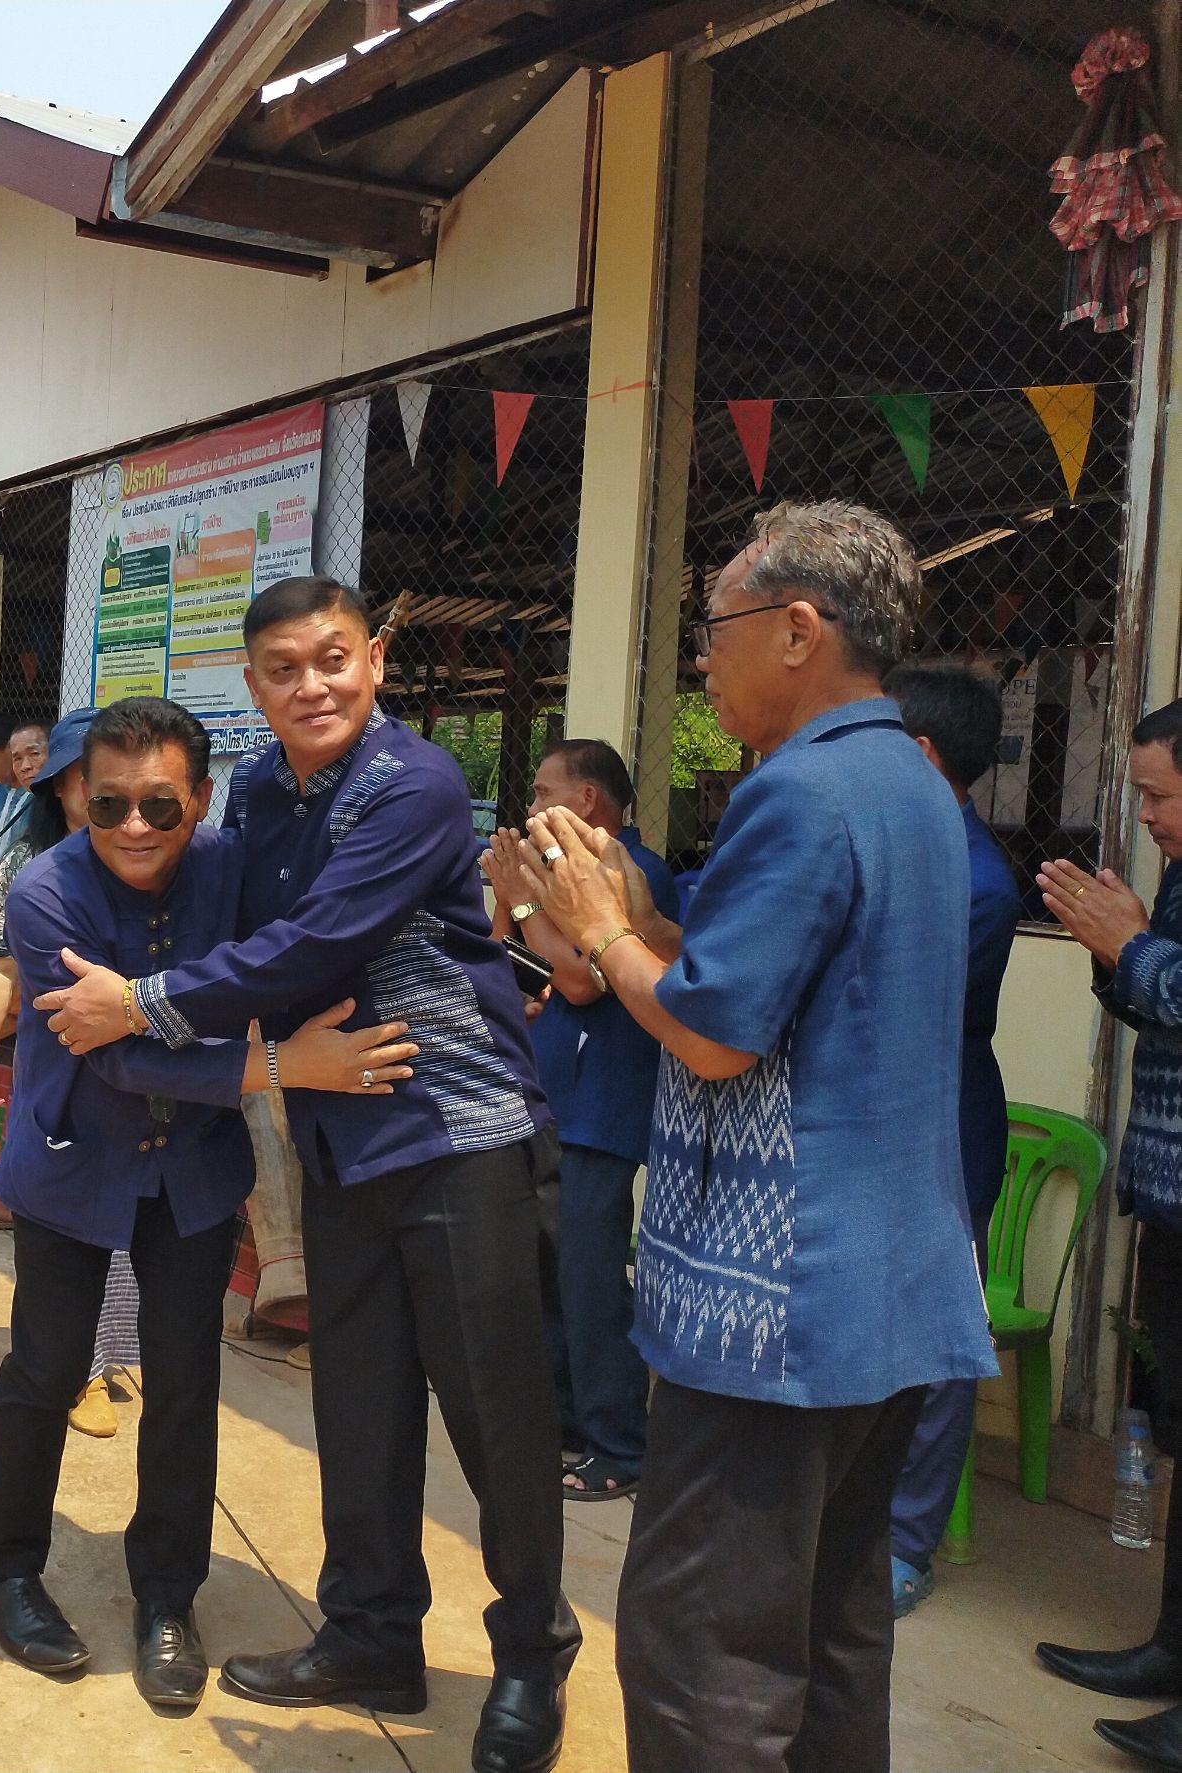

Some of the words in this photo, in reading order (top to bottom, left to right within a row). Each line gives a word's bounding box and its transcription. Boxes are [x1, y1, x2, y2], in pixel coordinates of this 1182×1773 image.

[123, 460, 167, 496] ประกาศ
[121, 501, 132, 518] เรื่อง
[228, 731, 242, 749] โทร.
[244, 733, 273, 749] 0-4297
